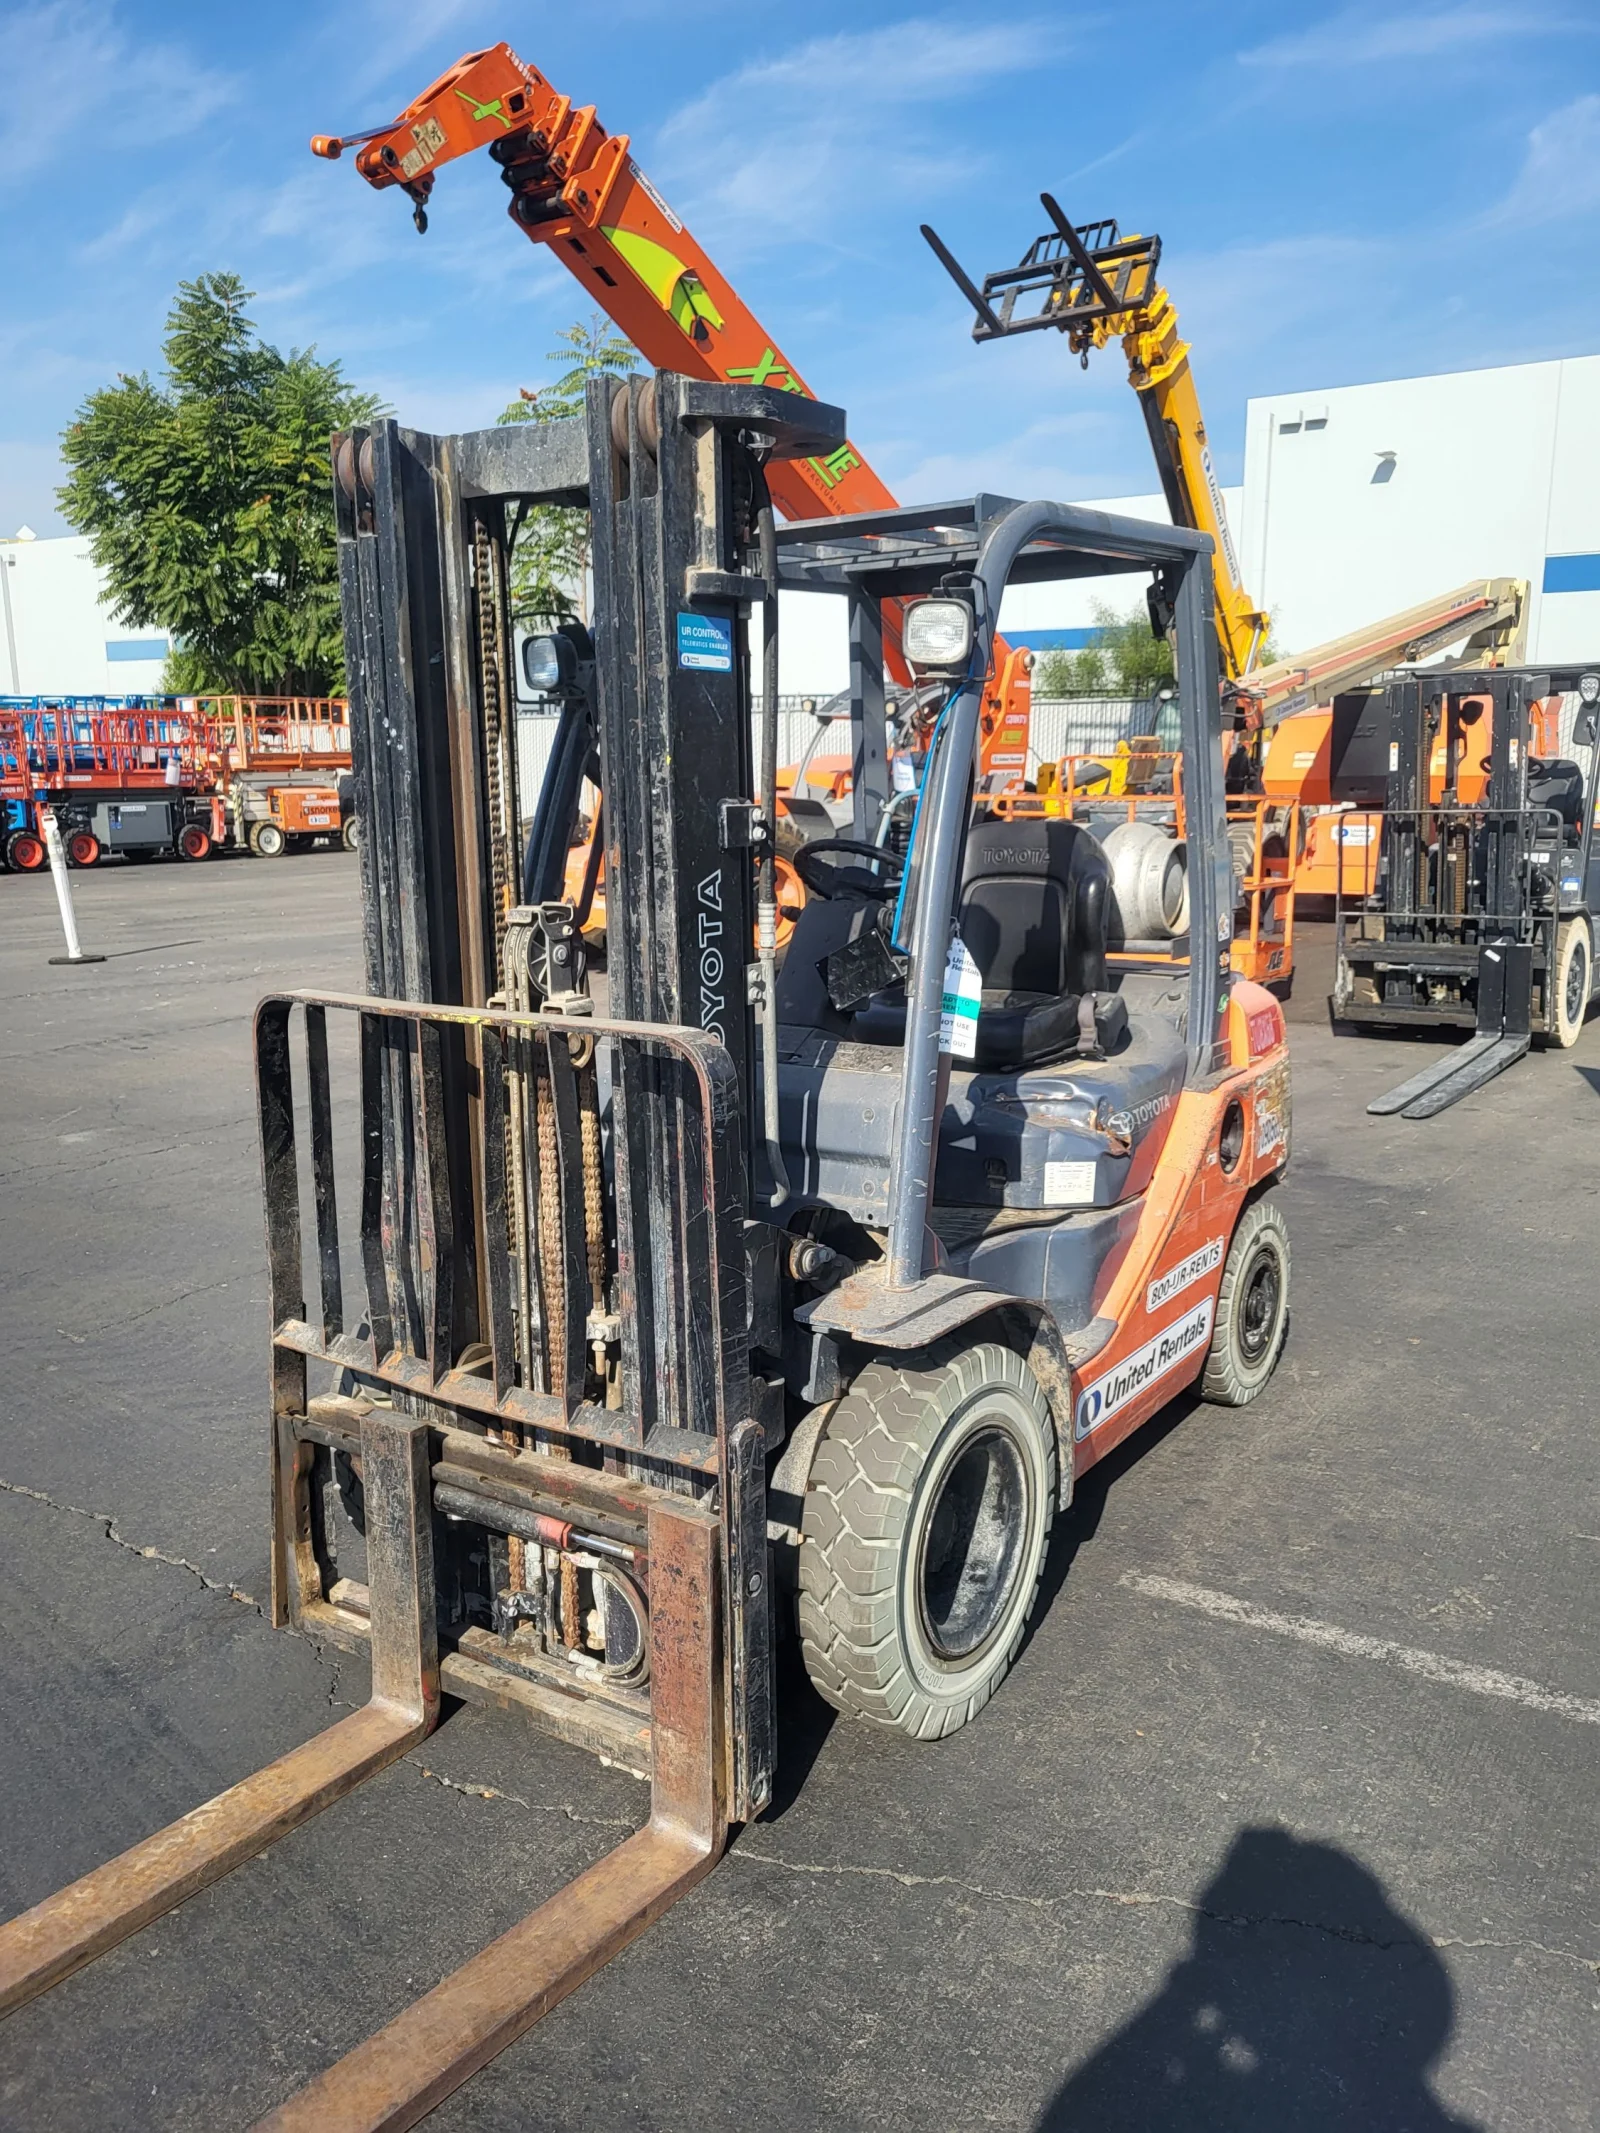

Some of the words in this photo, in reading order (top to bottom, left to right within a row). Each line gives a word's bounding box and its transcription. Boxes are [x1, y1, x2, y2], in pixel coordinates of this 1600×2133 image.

[1208, 475, 1225, 525] United
[1221, 526, 1237, 582] Rentals
[681, 626, 691, 636] UR
[692, 627, 724, 639] CONTROL
[982, 846, 1051, 866] TOYOTA
[956, 1021, 970, 1030] USE
[952, 1040, 967, 1048] OUT
[1132, 1094, 1171, 1124] TOYOTA
[1104, 1348, 1155, 1409] United
[1157, 1313, 1206, 1369] Rentals
